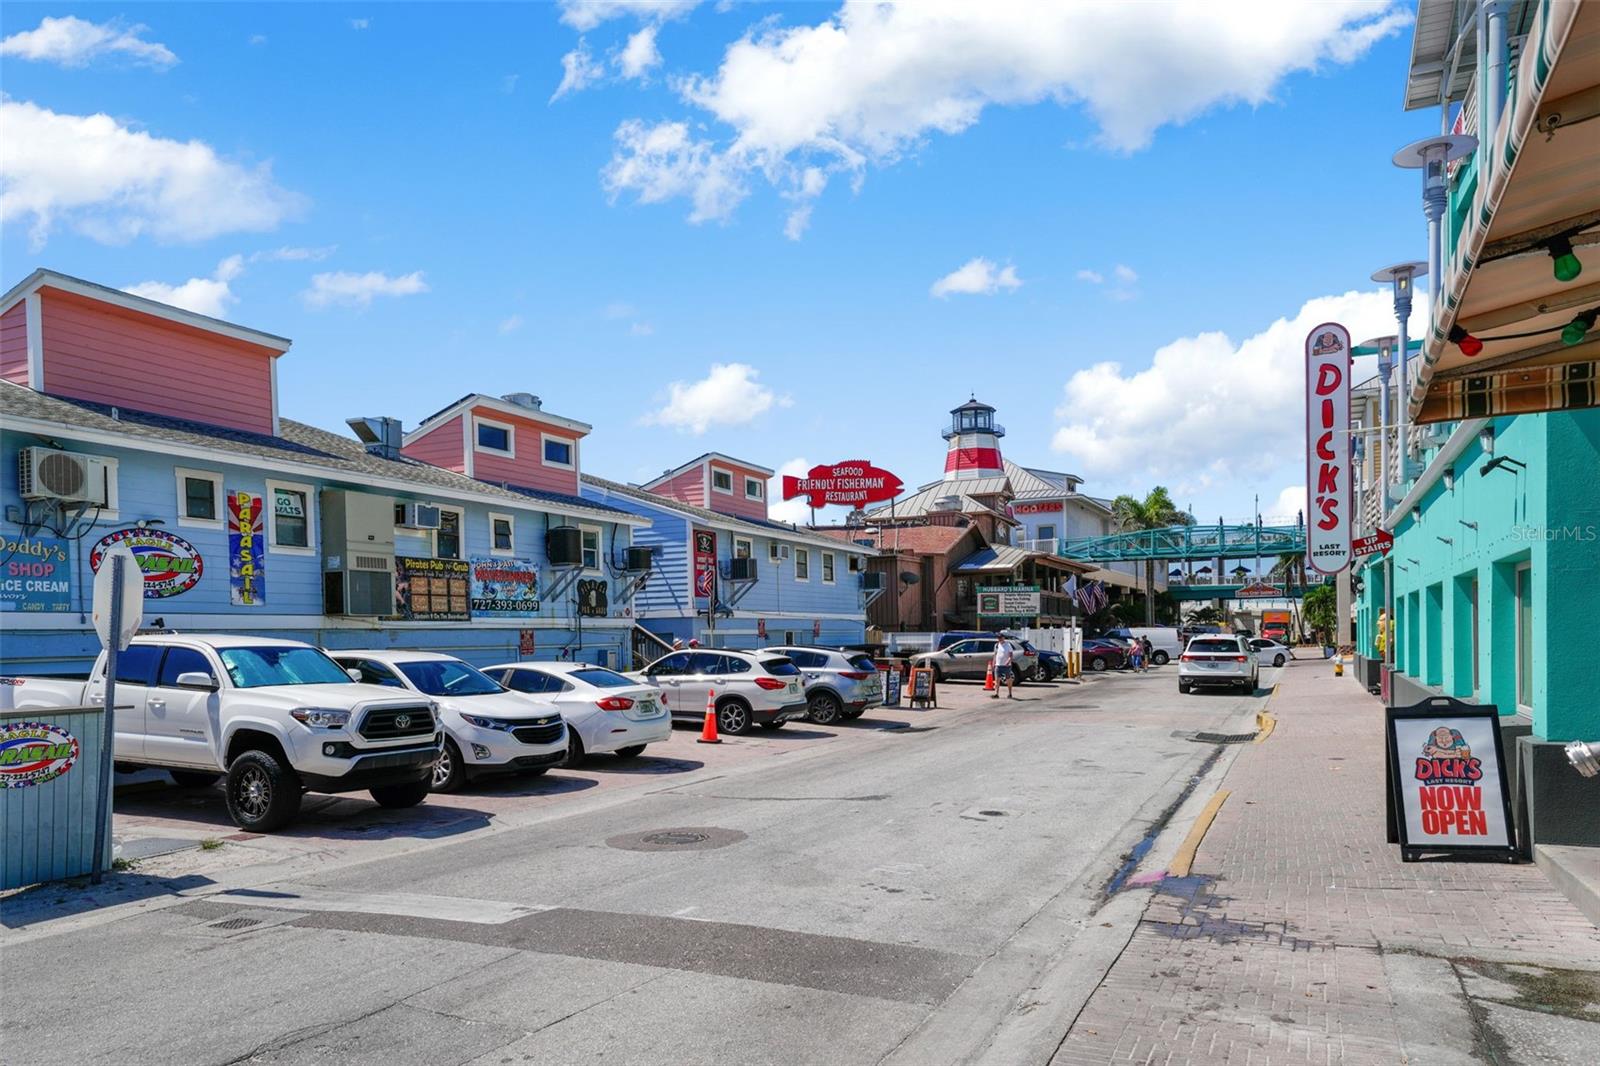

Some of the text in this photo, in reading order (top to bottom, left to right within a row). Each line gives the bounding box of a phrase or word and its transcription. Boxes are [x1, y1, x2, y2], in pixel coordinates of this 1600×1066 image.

[1315, 363, 1343, 531] DICK'S
[832, 467, 864, 477] SEAFOOD
[797, 477, 885, 491] FRIENDLY FISHERMAN
[276, 497, 291, 506] GO
[825, 490, 868, 501] RESTAURANT
[124, 537, 174, 551] EAGLE
[1354, 540, 1392, 555] STAIRS
[1363, 536, 1379, 545] UP
[236, 491, 255, 605] PARASAIL
[8, 561, 56, 577] SHOP
[405, 558, 429, 570] Pirates
[430, 560, 444, 571] Pub
[452, 562, 469, 572] Grub
[25, 580, 69, 593] CREAM
[473, 599, 539, 611] 727-393-0699
[1416, 758, 1482, 780] DICK'S
[1419, 786, 1482, 811] NOW
[1422, 810, 1488, 835] OPEN
